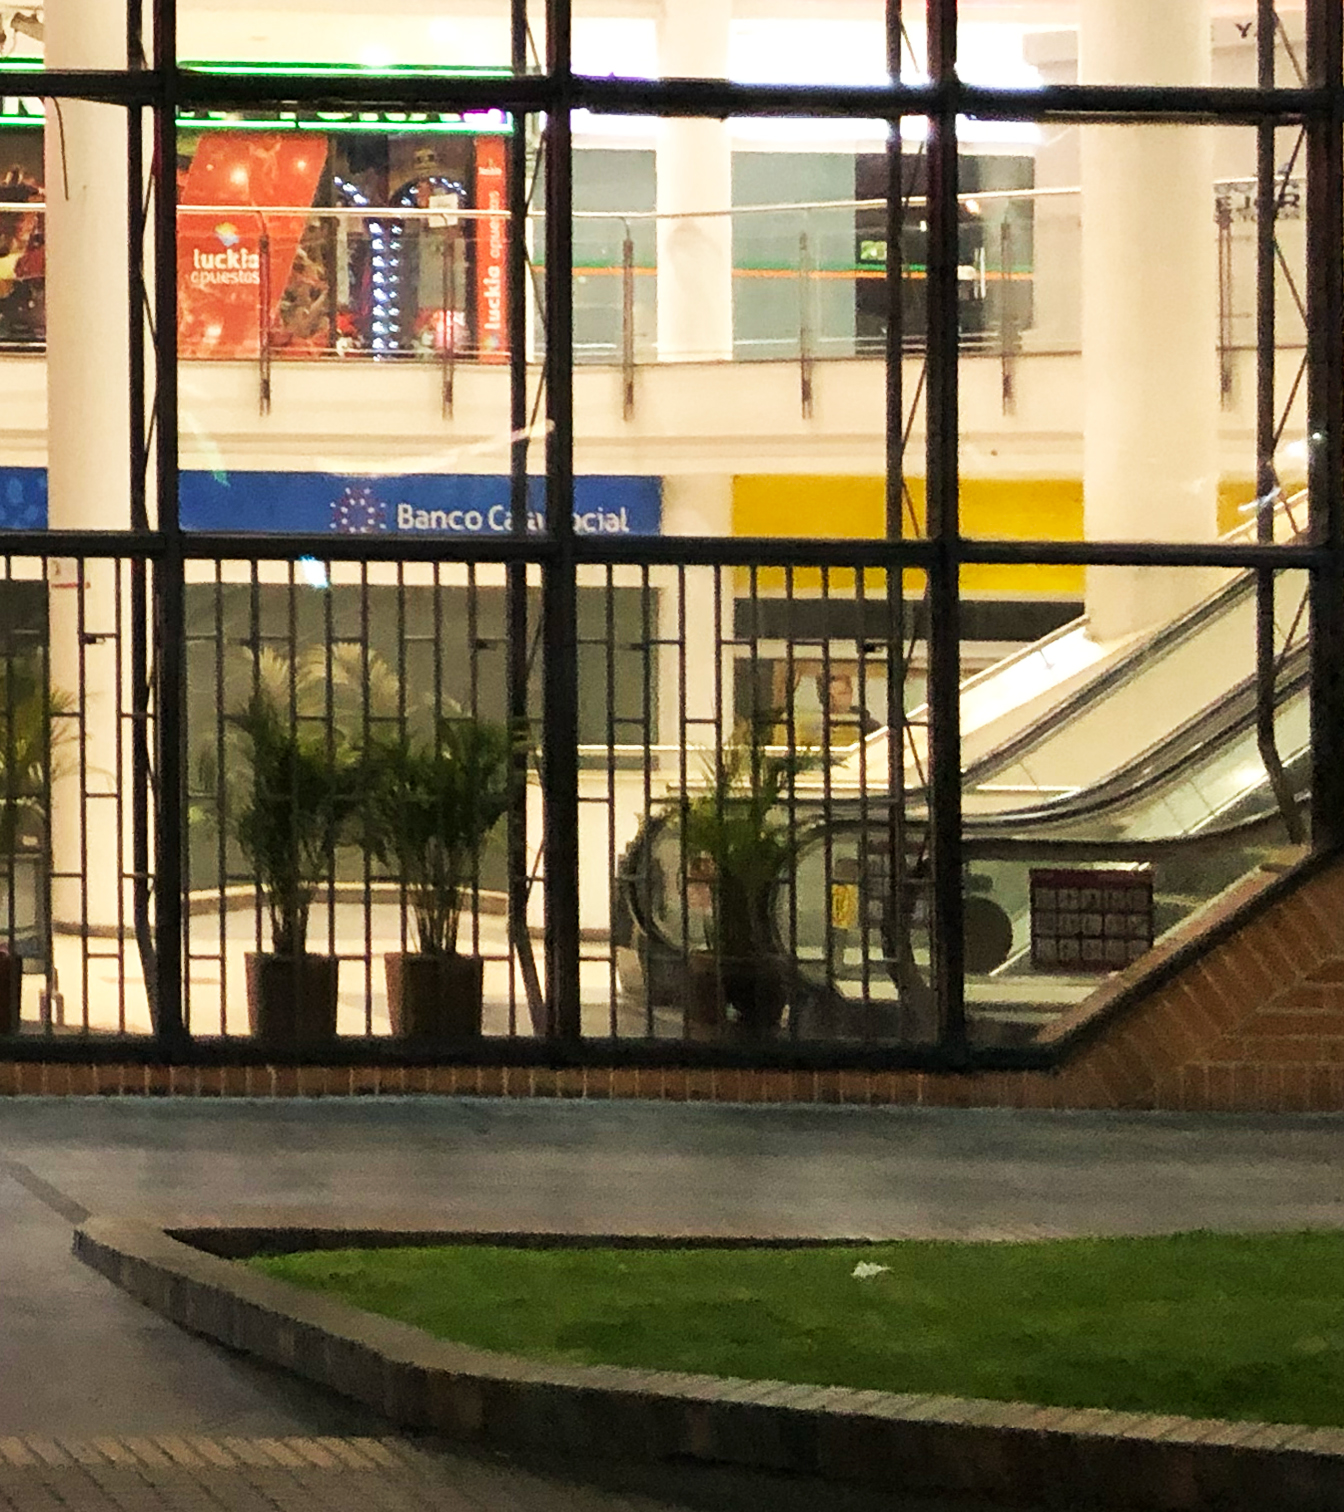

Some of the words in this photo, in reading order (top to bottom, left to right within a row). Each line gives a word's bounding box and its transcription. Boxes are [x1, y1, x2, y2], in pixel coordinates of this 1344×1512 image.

[193, 248, 260, 269] luckia
[190, 270, 261, 289] apuestas
[483, 264, 502, 331] luckia
[397, 502, 484, 531] Banco
